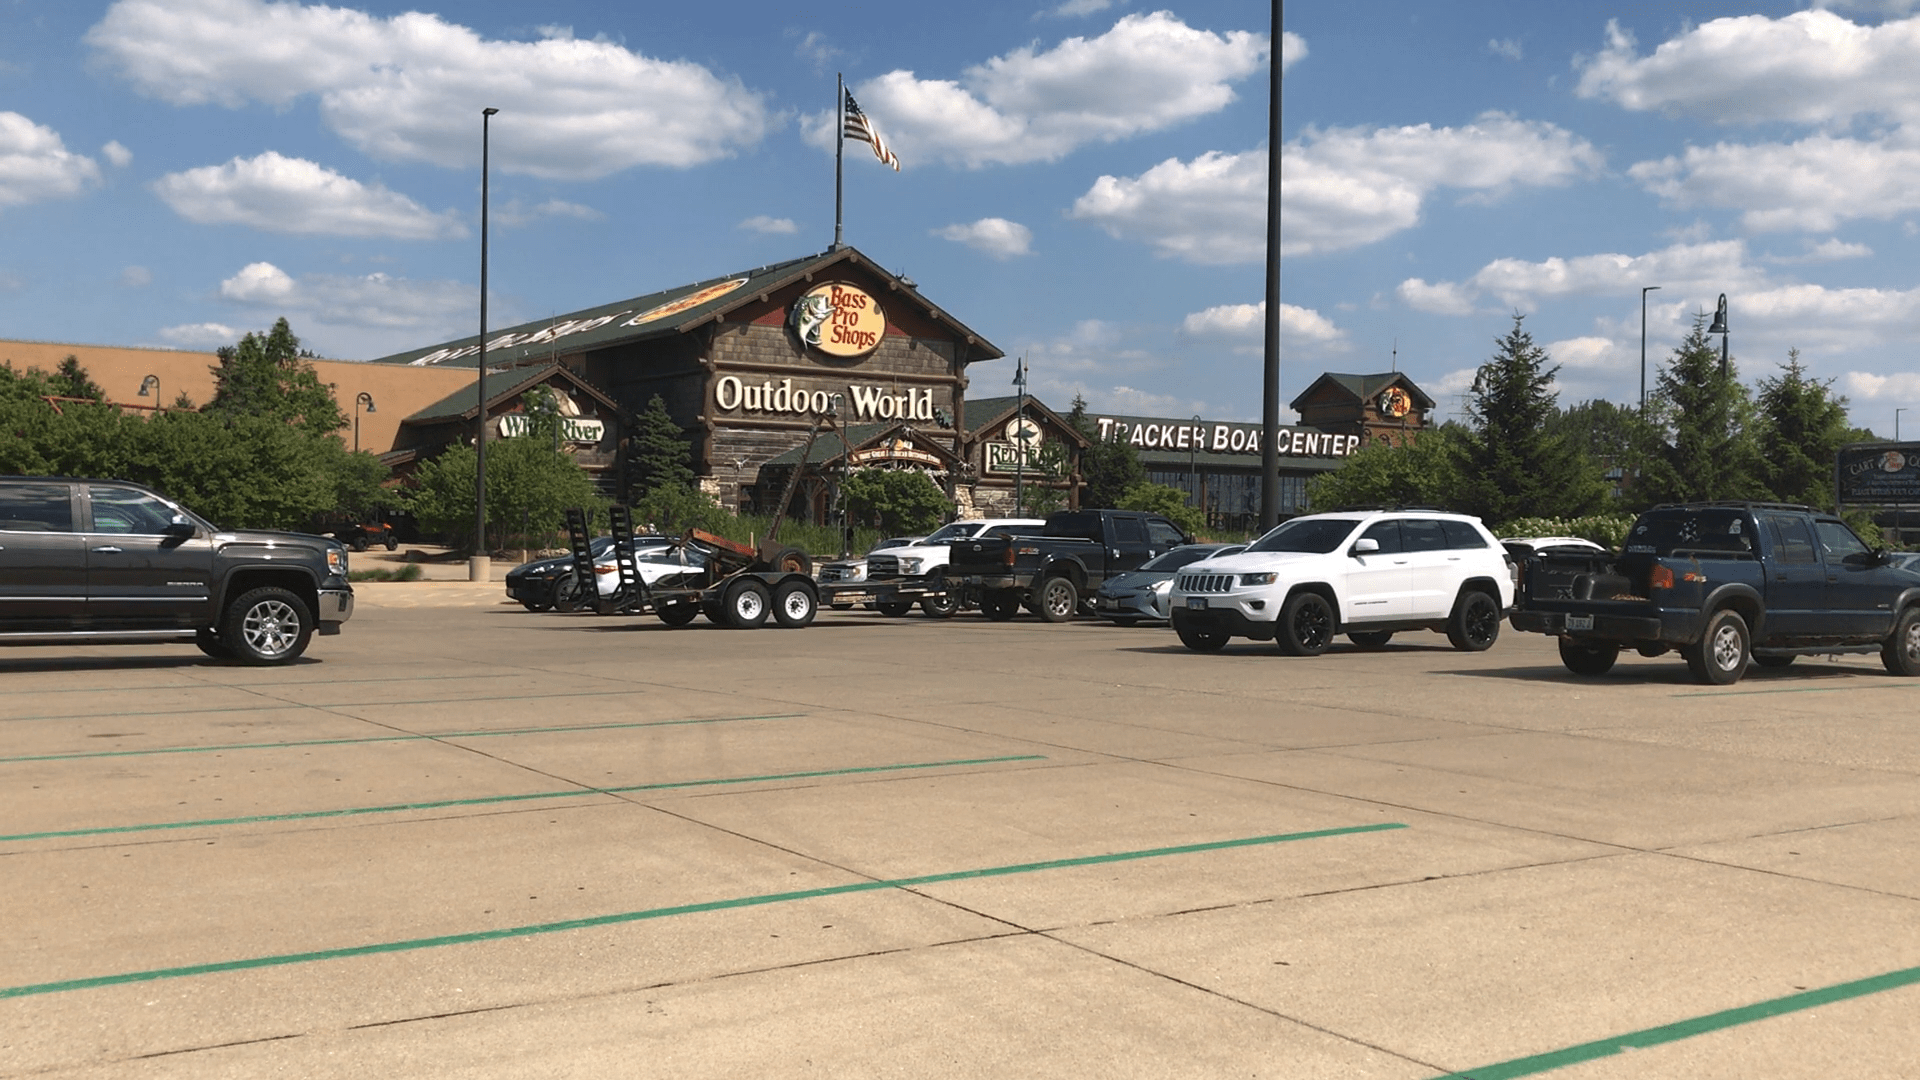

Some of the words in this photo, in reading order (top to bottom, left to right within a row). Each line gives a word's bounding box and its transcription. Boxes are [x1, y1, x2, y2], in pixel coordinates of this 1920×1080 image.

[831, 286, 867, 309] Bass
[831, 306, 859, 326] Pro
[830, 325, 876, 349] Shops
[716, 376, 842, 416] Outdoor
[850, 385, 934, 421] World
[562, 419, 601, 440] River
[1098, 418, 1206, 449] TRACKER
[1213, 425, 1264, 451] BOA
[1278, 429, 1360, 455] CENTER
[1850, 458, 1875, 475] CART
